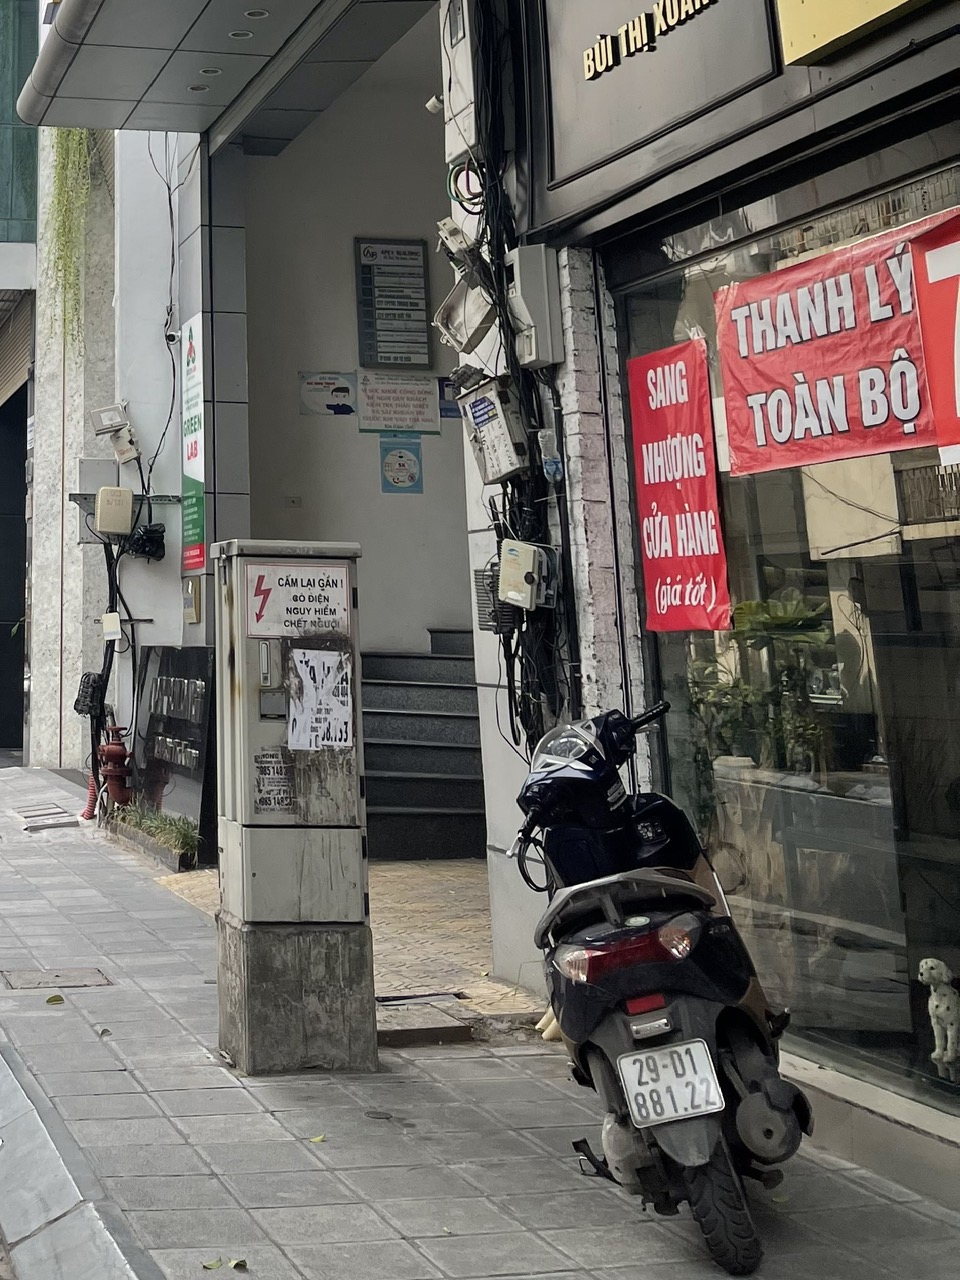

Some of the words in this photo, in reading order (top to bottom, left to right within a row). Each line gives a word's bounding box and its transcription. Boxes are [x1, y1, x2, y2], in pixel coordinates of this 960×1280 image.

[583, 34, 618, 82] BÙI
[618, 11, 654, 54] THỊ
[731, 273, 855, 358] THANH
[864, 241, 914, 322] LÝ
[647, 360, 689, 410] SANG
[747, 373, 846, 447] TOÀN
[858, 348, 920, 434] BỘ
[183, 412, 202, 437] GREEN
[187, 440, 198, 462] LAB
[642, 433, 708, 490] NHƯỢNG
[642, 500, 673, 560] CỬA
[677, 498, 720, 556] HÀNG
[278, 574, 298, 588] CẤM
[301, 578, 315, 590] LẠI
[308, 593, 329, 604] ĐIỆN
[284, 617, 308, 627] CHẾT
[286, 607, 311, 615] NGUY
[314, 604, 336, 616] HIỂM
[632, 1048, 698, 1086] 29-D1
[634, 1076, 717, 1121] 881.22
